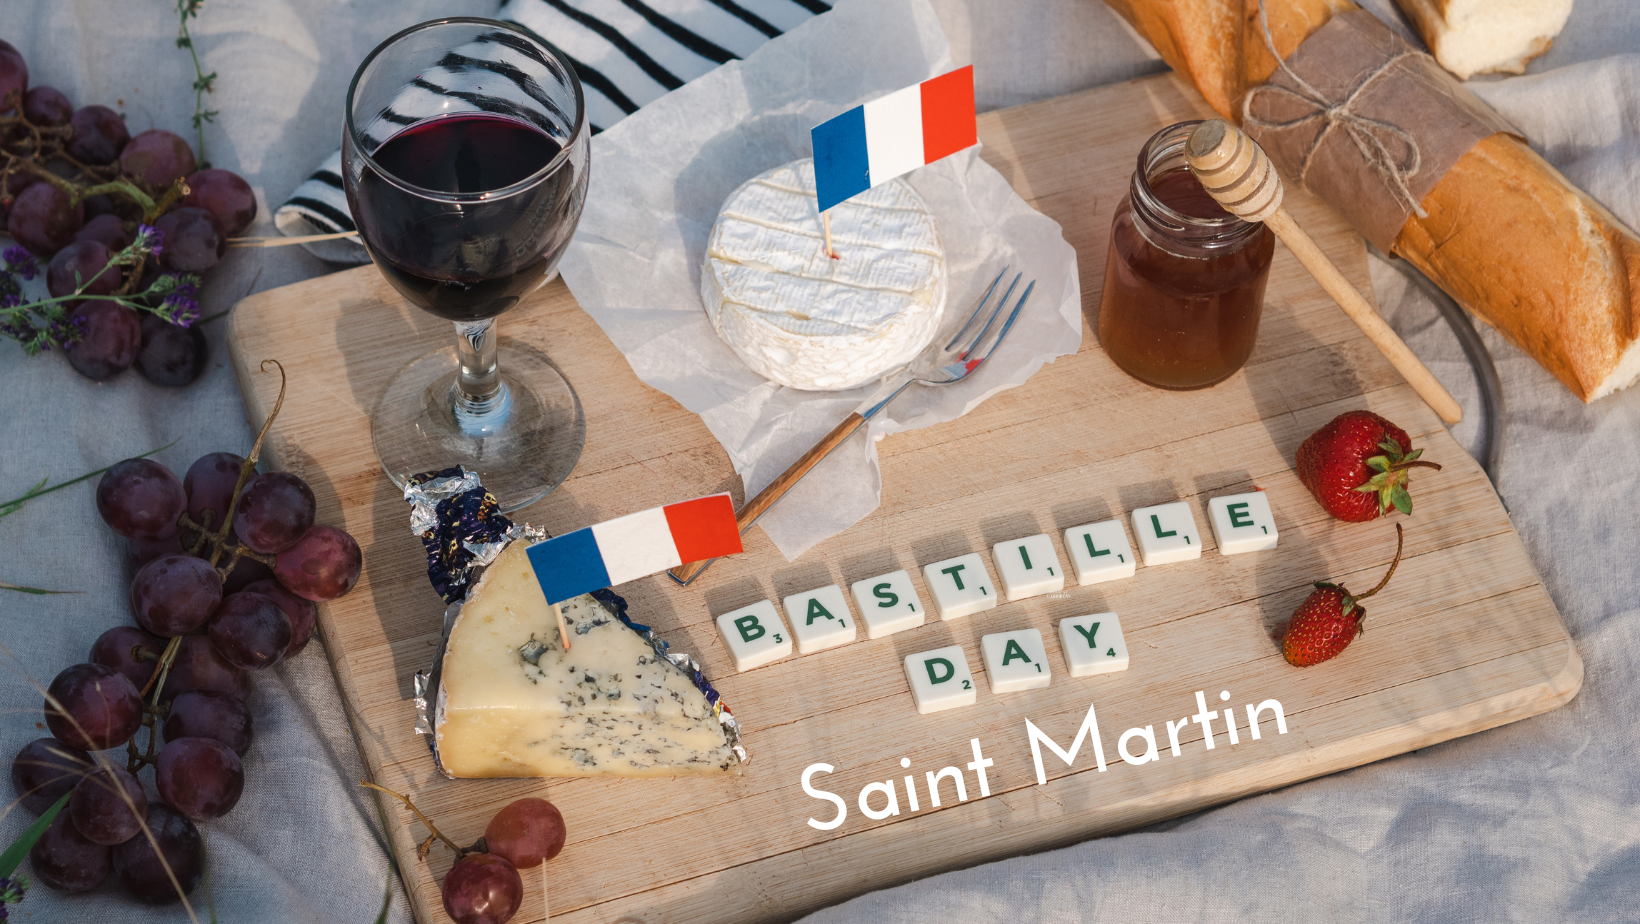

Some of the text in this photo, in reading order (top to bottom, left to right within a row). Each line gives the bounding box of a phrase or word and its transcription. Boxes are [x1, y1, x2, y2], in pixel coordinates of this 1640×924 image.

[1260, 525, 1269, 535] 1
[1183, 535, 1191, 545] 1
[1117, 553, 1125, 564] 1
[734, 502, 1255, 643] BASTILLE
[1046, 566, 1055, 577] 1
[979, 586, 988, 596] 1
[907, 602, 916, 612] 1
[838, 618, 847, 628] 1
[772, 633, 783, 644] 3
[924, 622, 1101, 685] DAY
[1106, 647, 1116, 658] 4
[1034, 662, 1042, 673] 1
[961, 679, 971, 690] 2
